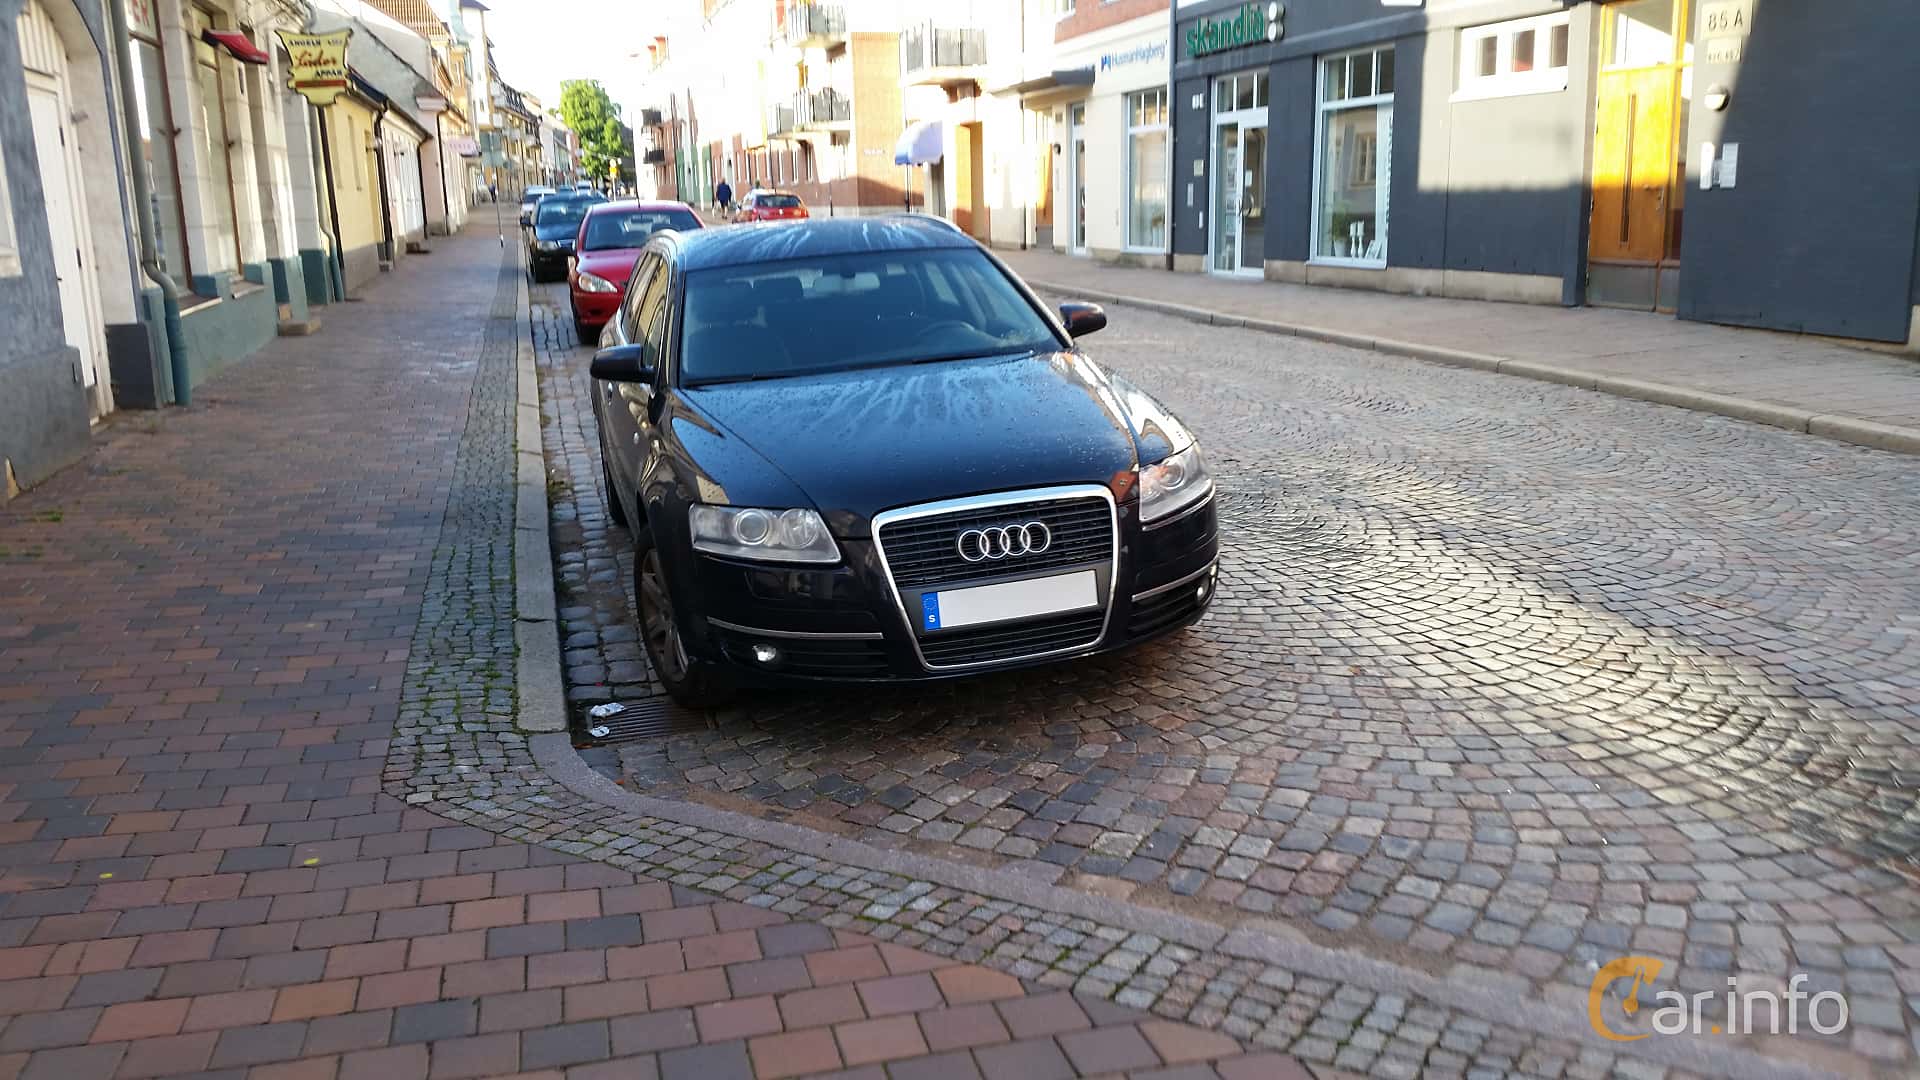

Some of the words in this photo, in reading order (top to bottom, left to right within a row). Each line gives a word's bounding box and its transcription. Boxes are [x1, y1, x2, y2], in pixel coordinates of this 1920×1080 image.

[1733, 8, 1743, 27] A
[1186, 3, 1264, 56] skandia
[928, 614, 936, 623] S
